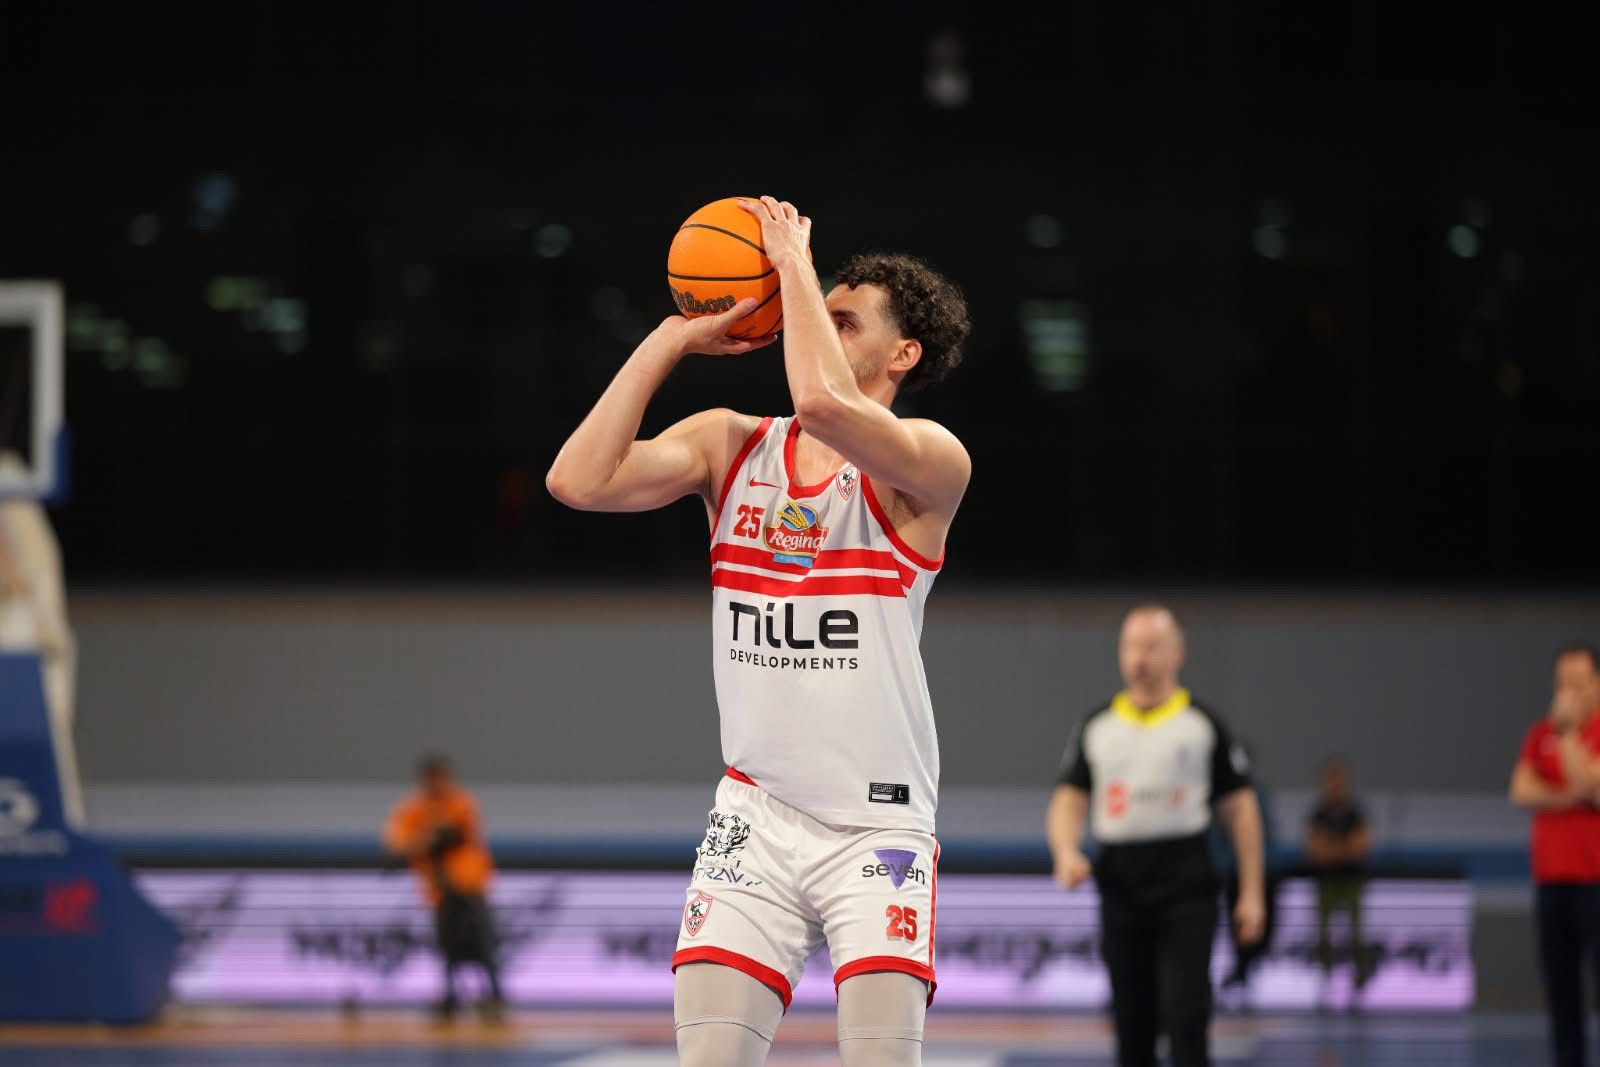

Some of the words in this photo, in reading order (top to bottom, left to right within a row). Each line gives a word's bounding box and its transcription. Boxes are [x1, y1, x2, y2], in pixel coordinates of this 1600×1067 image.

[733, 504, 766, 540] 25
[730, 649, 859, 670] DEVELOPMENTS
[898, 789, 904, 799] L
[862, 863, 926, 885] seven
[885, 904, 918, 943] 25
